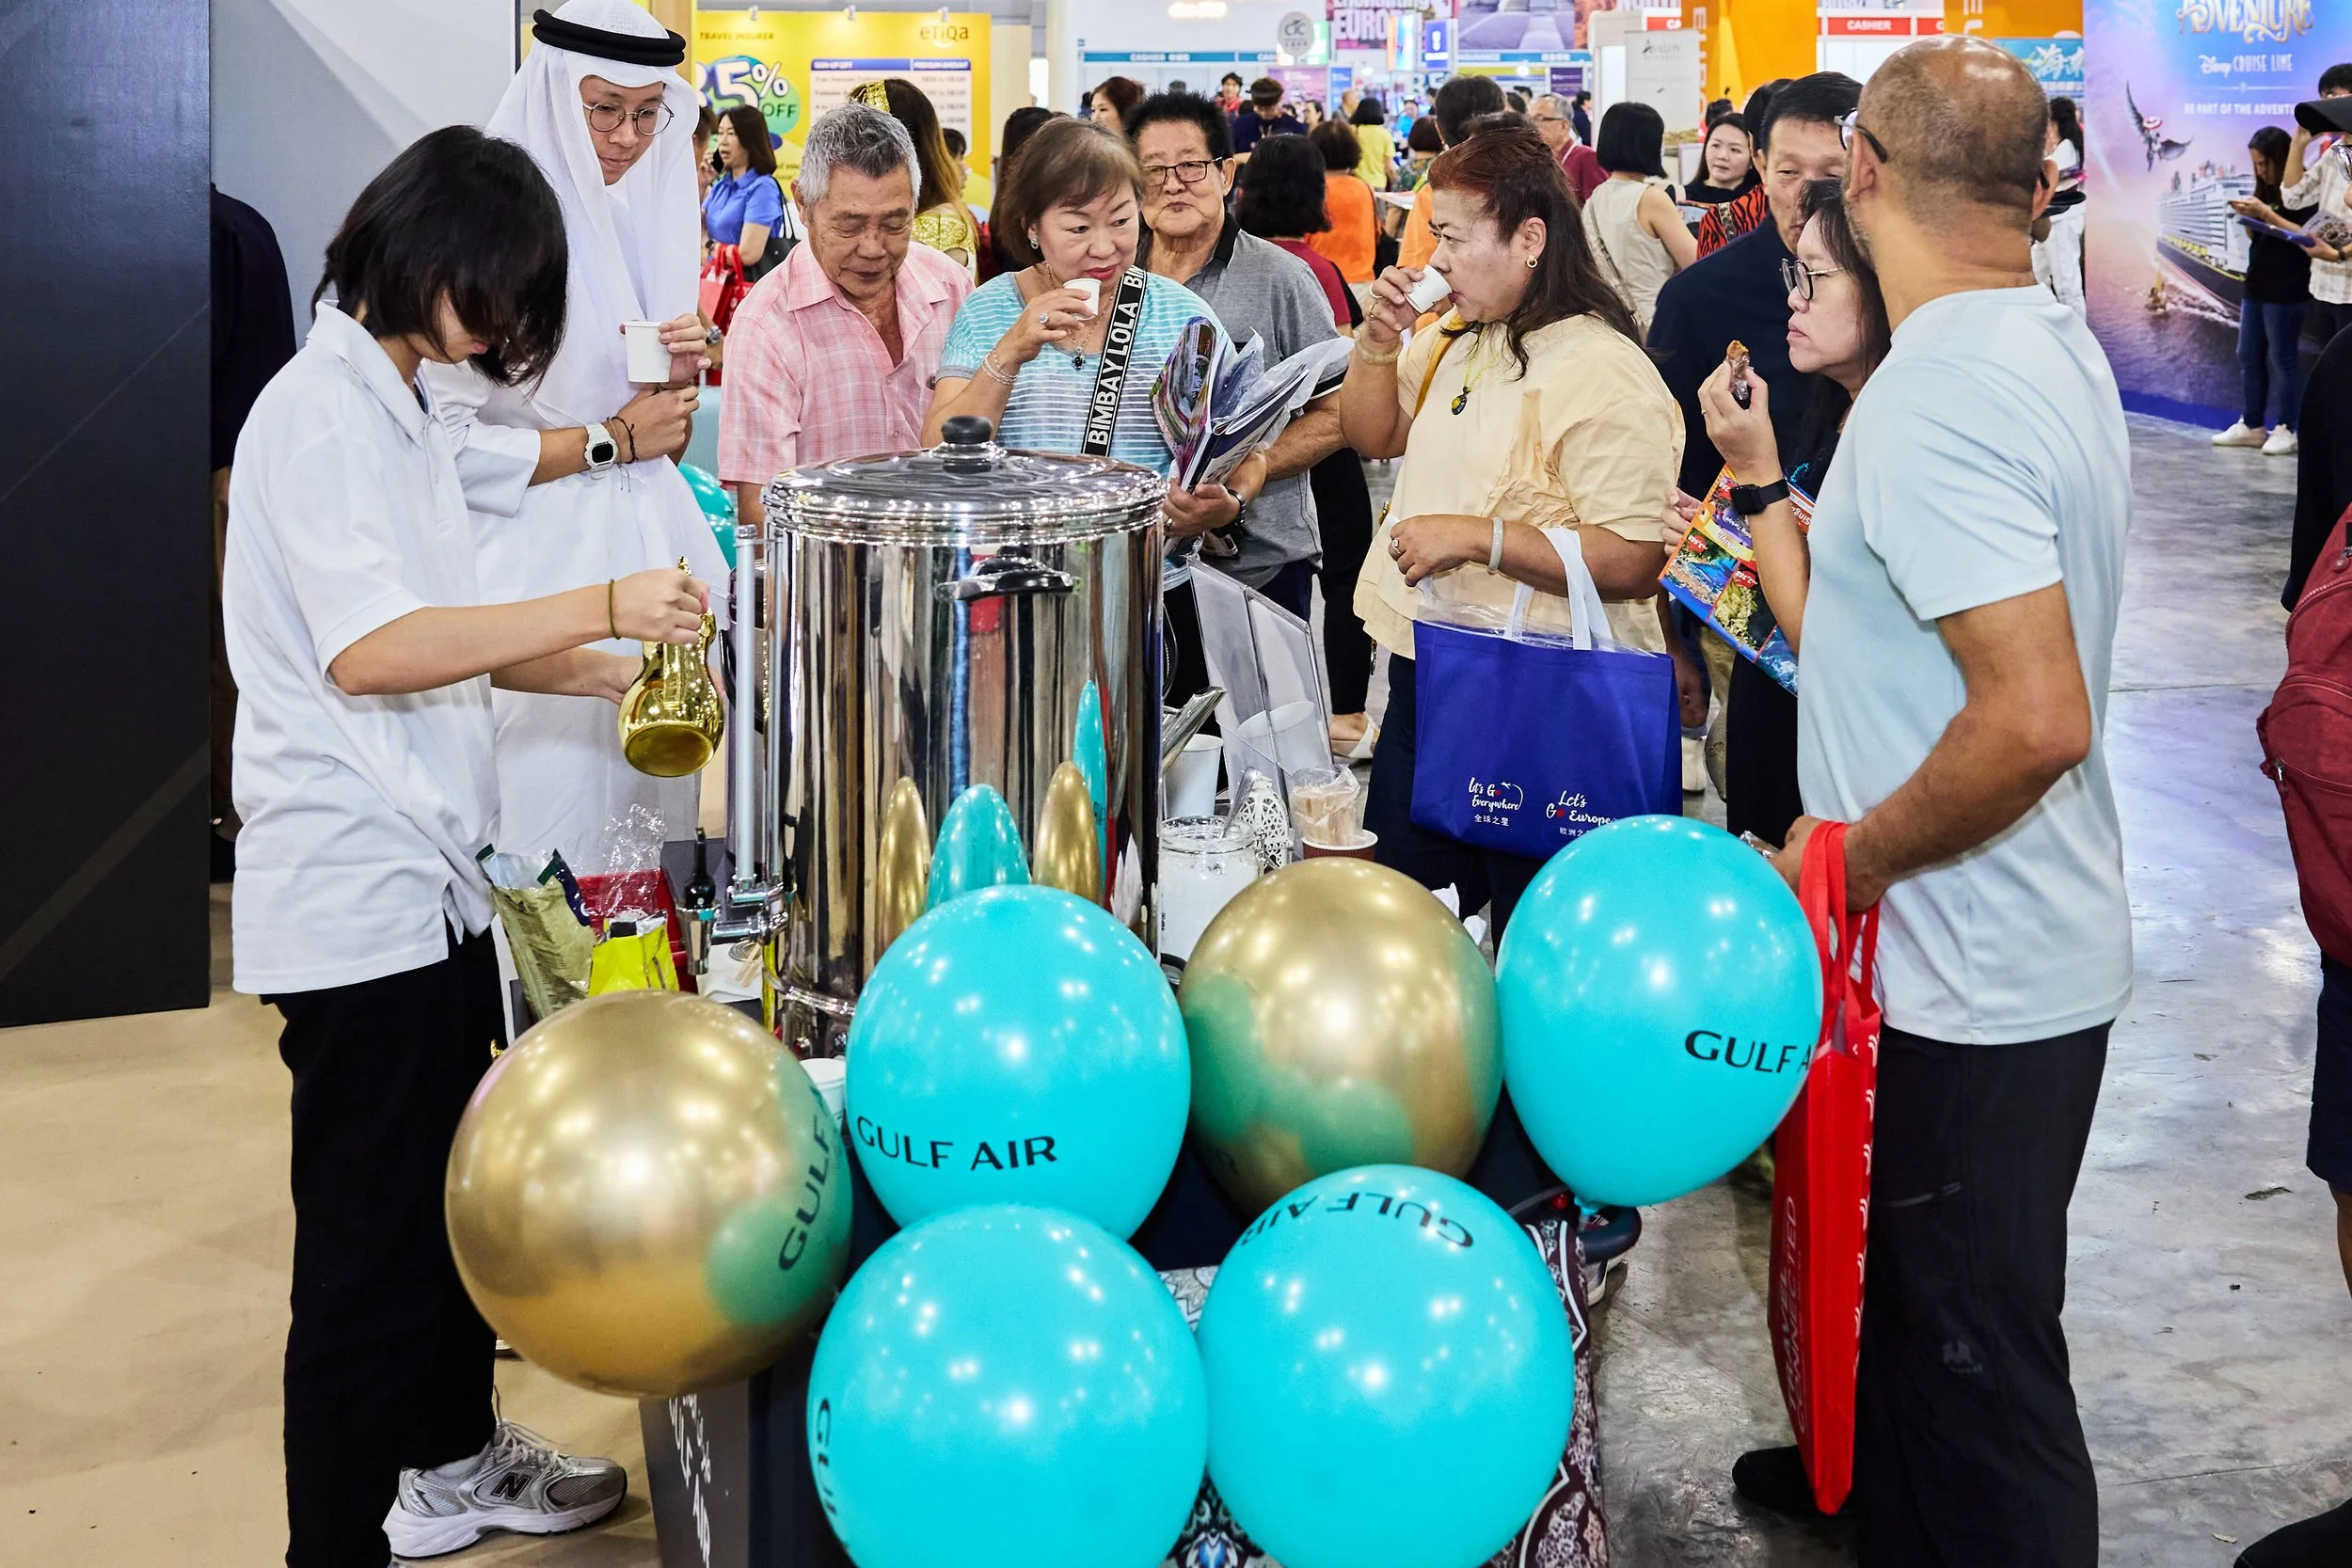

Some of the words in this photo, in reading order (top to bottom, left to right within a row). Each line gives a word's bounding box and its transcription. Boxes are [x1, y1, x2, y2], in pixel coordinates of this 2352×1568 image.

[1847, 20, 1892, 31] CASHIER
[2233, 54, 2266, 72] CRUISE
[2270, 54, 2293, 72] LINE
[762, 103, 797, 118] OFF
[2197, 103, 2217, 114] PART
[2219, 103, 2233, 114] OF
[2234, 103, 2251, 115] THE
[1110, 301, 1139, 361] LOLA
[1469, 777, 1484, 794] Let's
[1471, 795, 1519, 813] Everywhere
[1558, 790, 1587, 808] Let's
[1473, 814, 1510, 827] 全球之星
[1685, 1030, 1797, 1073] GULF
[857, 1115, 954, 1169] GULF
[970, 1135, 1058, 1172] AIR
[778, 1115, 829, 1271] GULF
[1326, 1192, 1474, 1248] GULF
[1781, 1195, 1807, 1435] CONNECTED
